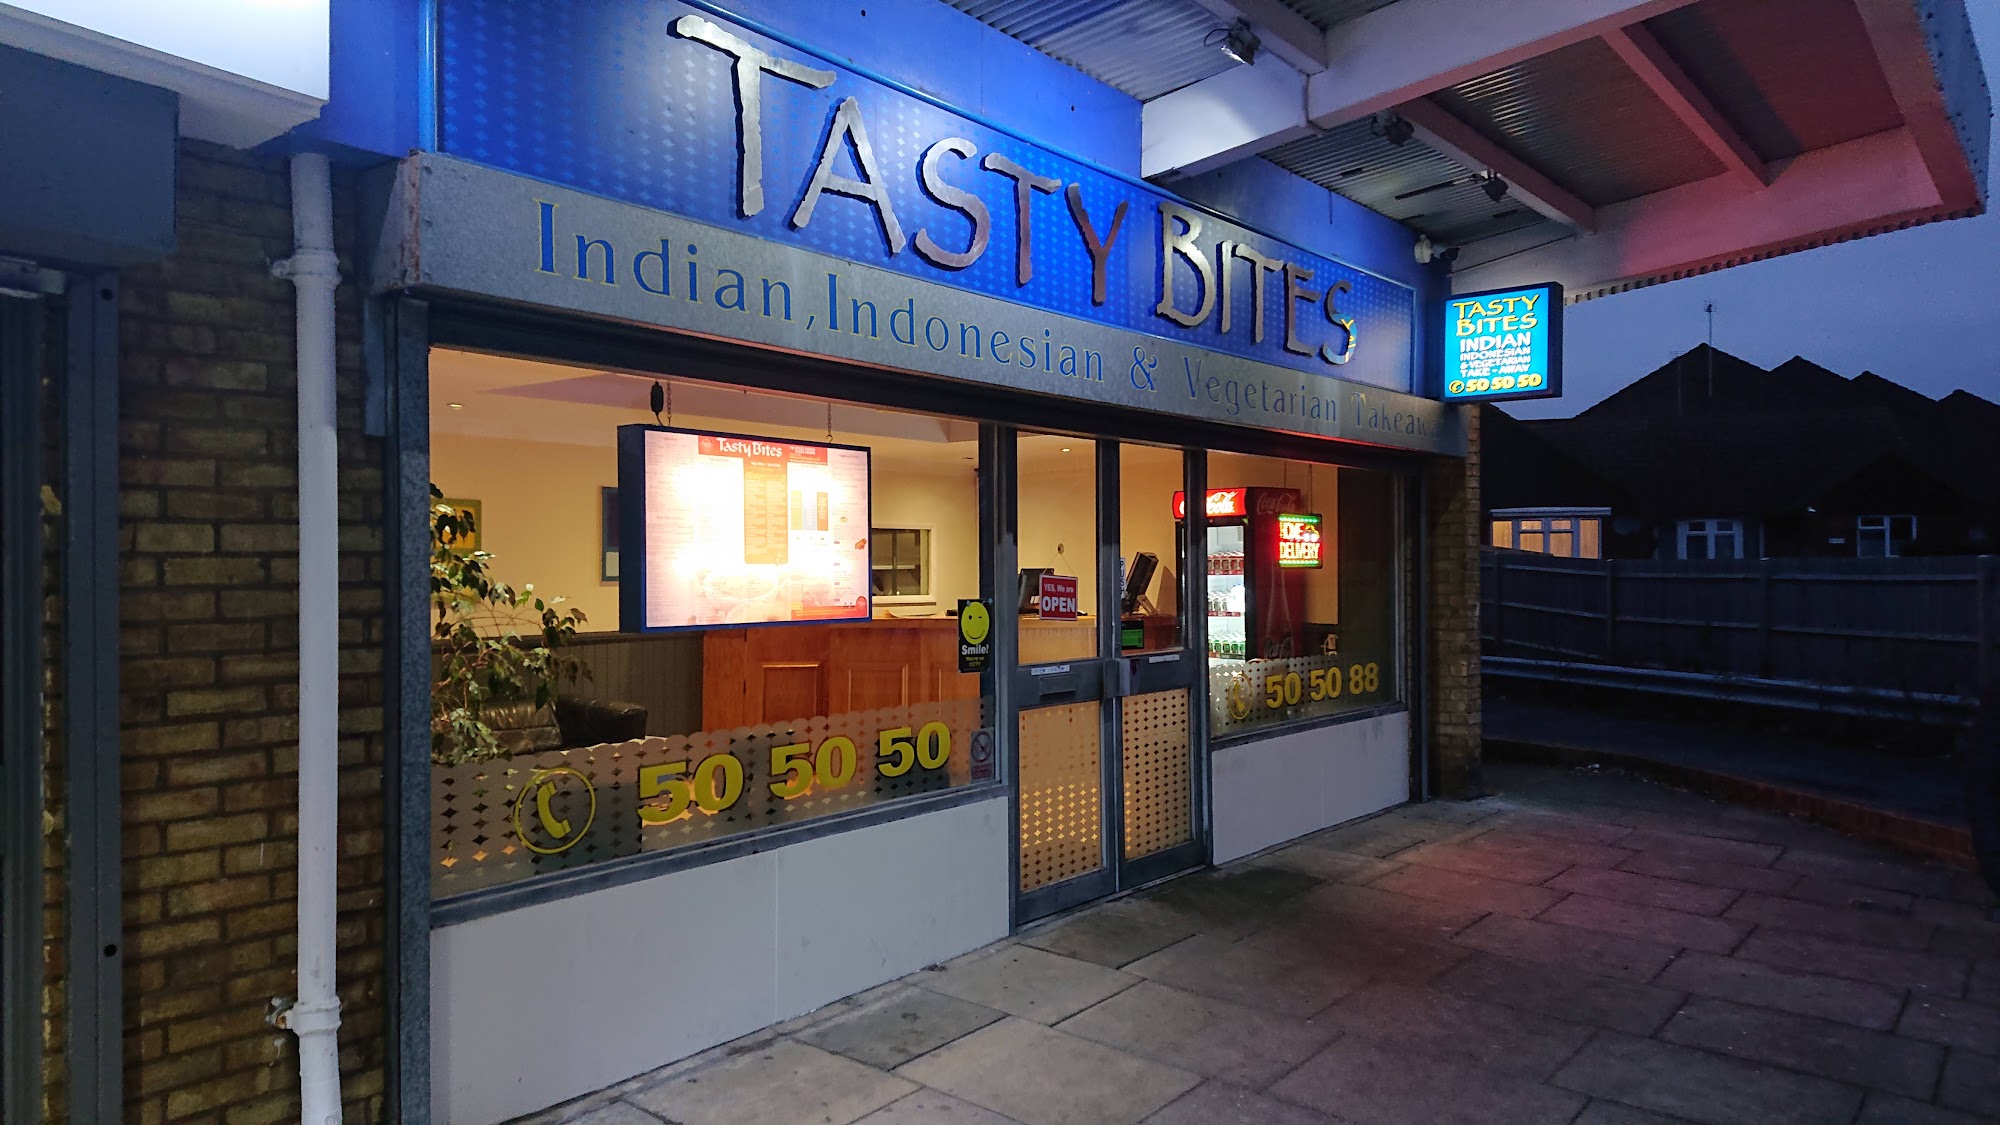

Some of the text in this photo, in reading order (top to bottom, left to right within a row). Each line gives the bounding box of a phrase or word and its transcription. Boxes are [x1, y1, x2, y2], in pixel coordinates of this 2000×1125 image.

[675, 14, 1358, 366] TASTY BITES
[1453, 294, 1540, 319] TASTY
[1456, 312, 1538, 336] BITES
[1460, 331, 1531, 353] INDIAN
[1460, 347, 1531, 361] INDONESIAN
[1469, 355, 1531, 369] VEGETARIAN
[1130, 345, 1158, 392] &
[1183, 356, 1337, 423] Vegetarian
[1466, 373, 1542, 392] 50 50 50
[717, 437, 751, 457] Tasty
[752, 441, 783, 458] Bites
[1280, 542, 1320, 559] DELIVERY
[1042, 595, 1076, 613] OPEN
[961, 644, 990, 656] Smile!
[1266, 662, 1379, 709] 50 50 88
[637, 721, 952, 825] 50 50 50
